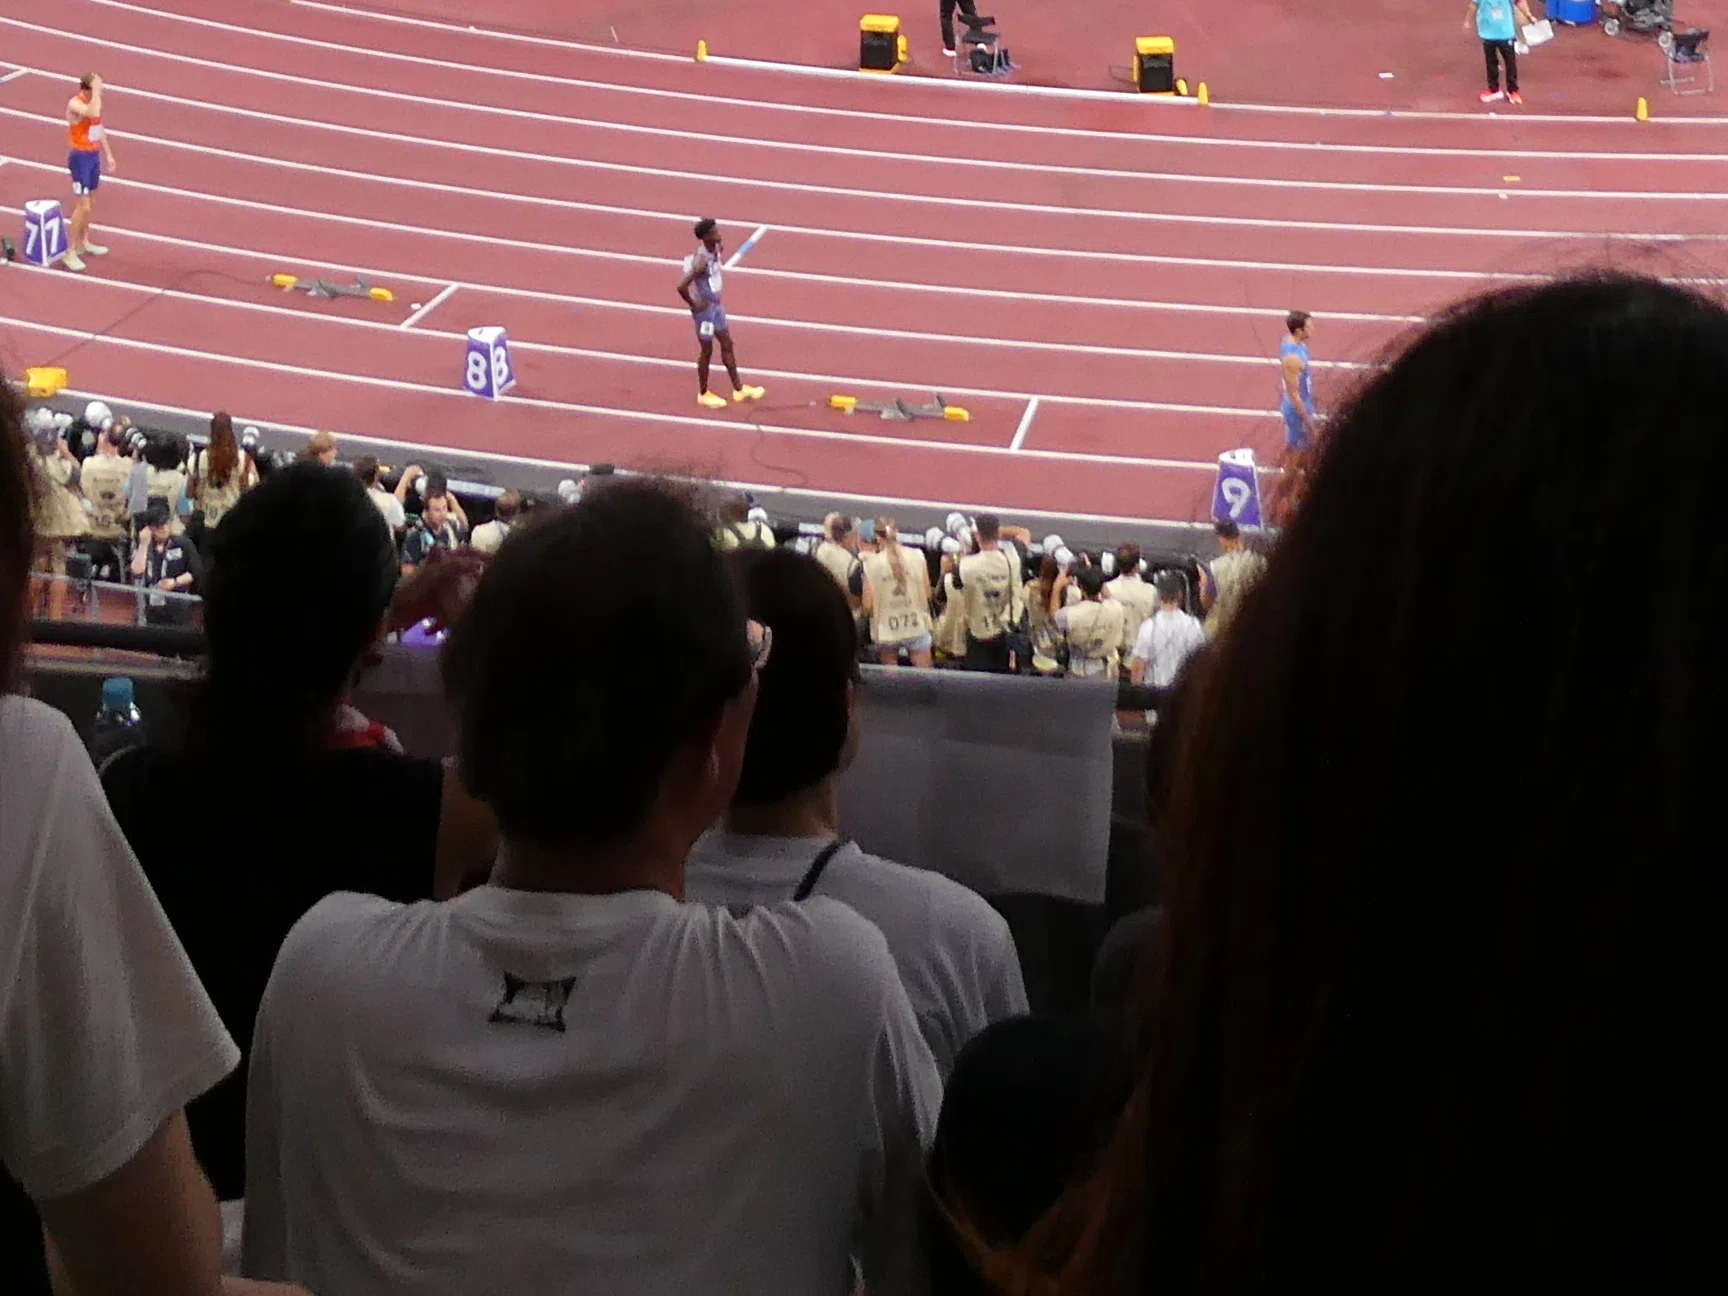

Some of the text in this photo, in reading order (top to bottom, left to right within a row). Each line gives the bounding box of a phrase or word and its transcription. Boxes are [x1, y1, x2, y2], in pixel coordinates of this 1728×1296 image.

[24, 220, 39, 256] 7
[46, 215, 61, 256] 7
[467, 350, 487, 391] 8
[494, 345, 508, 385] 8
[1220, 476, 1253, 518] 9
